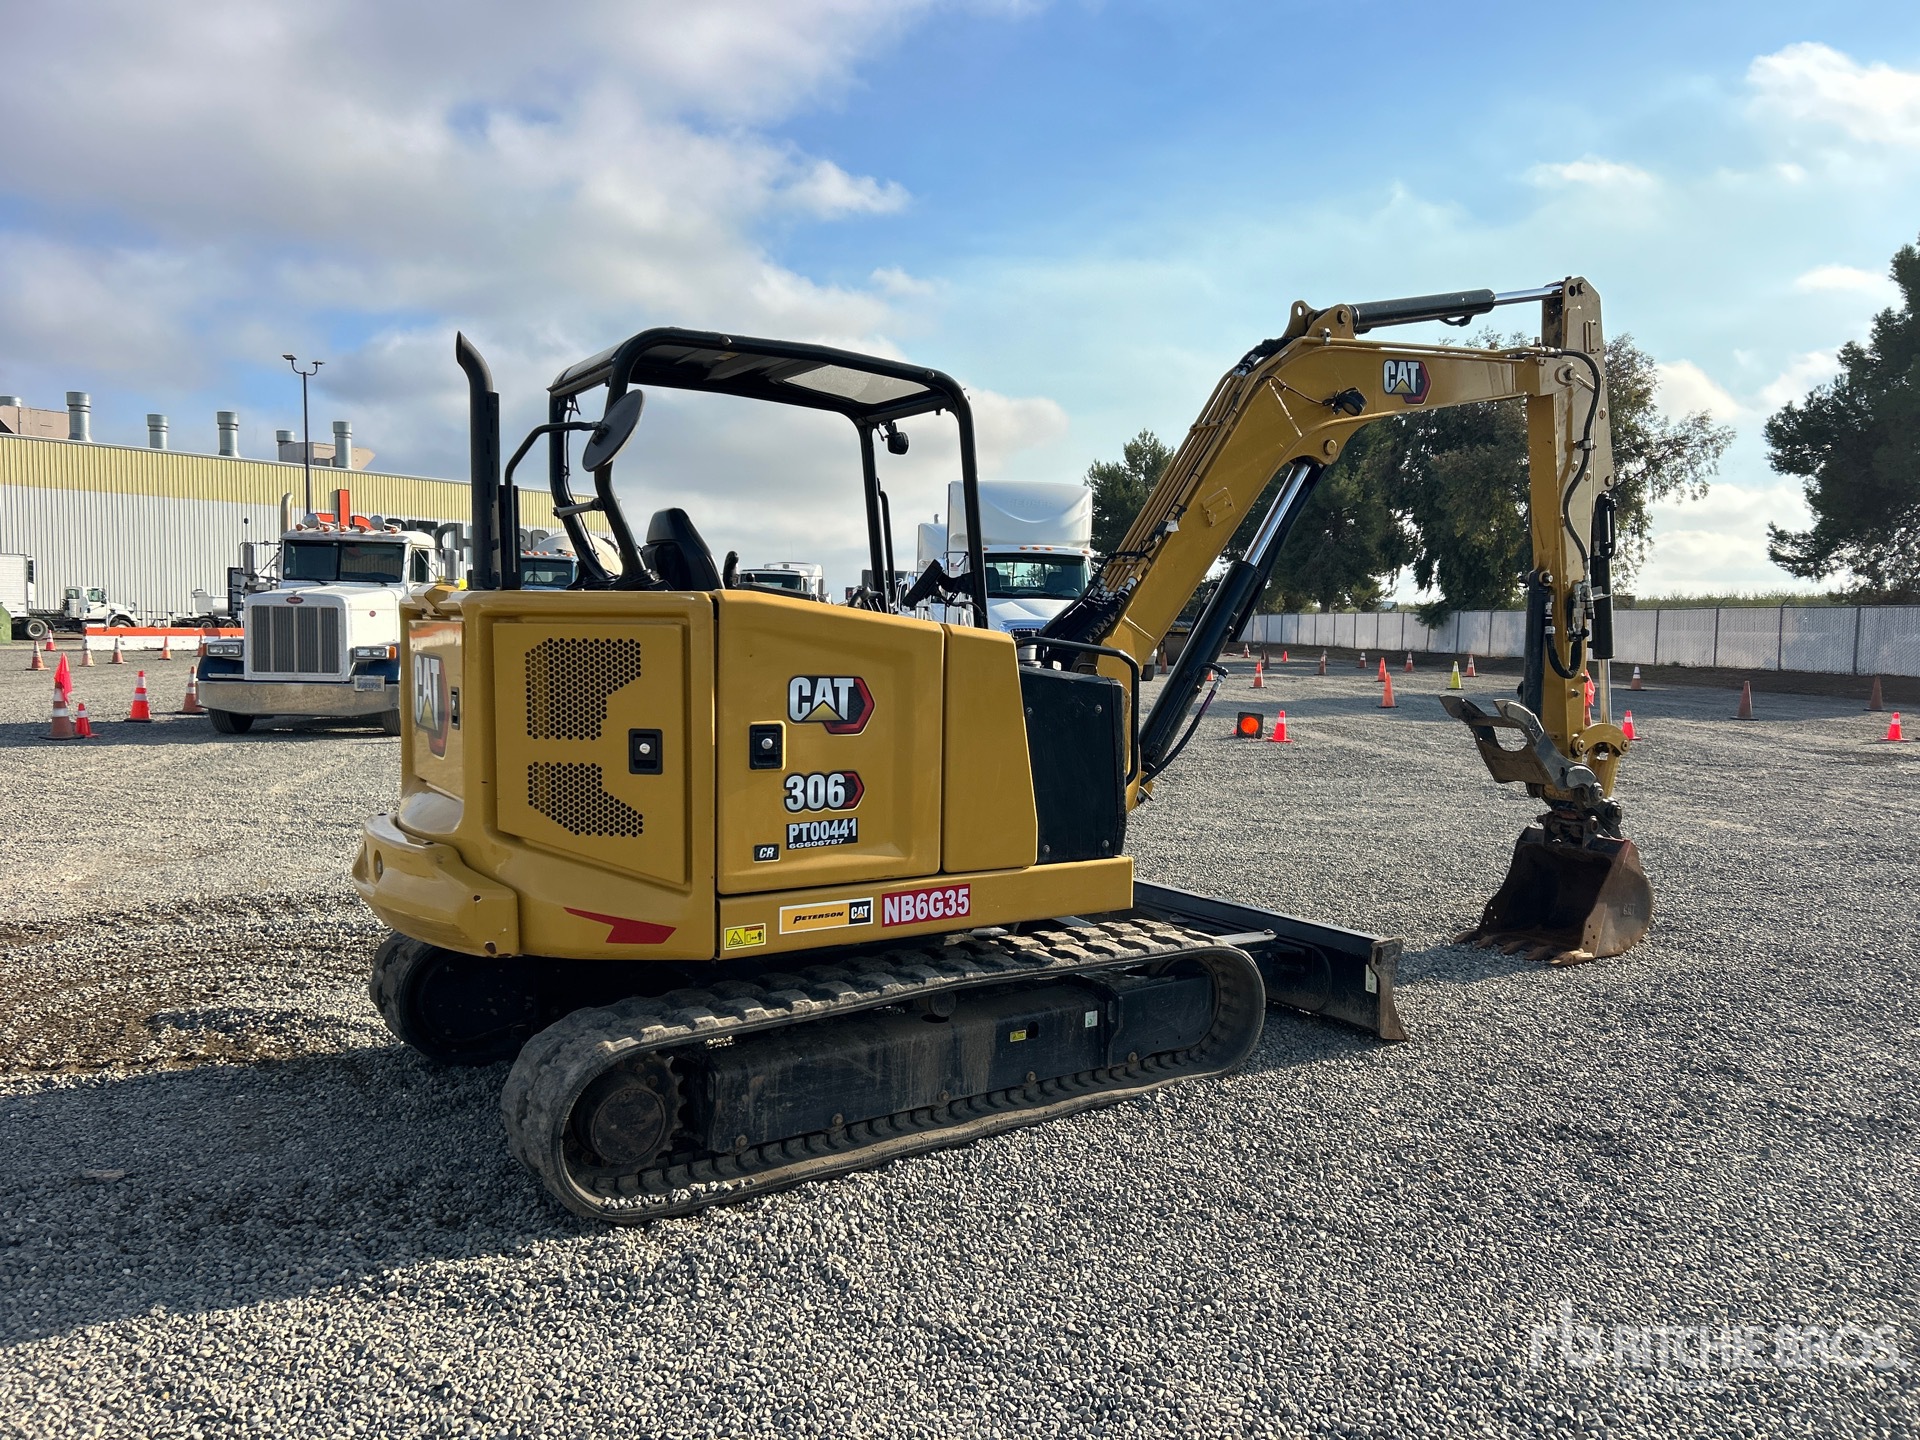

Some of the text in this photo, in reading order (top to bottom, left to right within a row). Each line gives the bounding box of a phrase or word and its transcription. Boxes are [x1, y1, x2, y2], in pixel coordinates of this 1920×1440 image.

[1384, 360, 1419, 394] CAT
[414, 654, 439, 731] CAT
[789, 677, 854, 721] CAT
[786, 773, 846, 811] 306
[788, 817, 857, 843] PT00441
[788, 838, 845, 849] 6G606787
[759, 846, 775, 858] CR
[793, 905, 870, 924] PETERSON CAT
[884, 888, 969, 924] NB6G35
